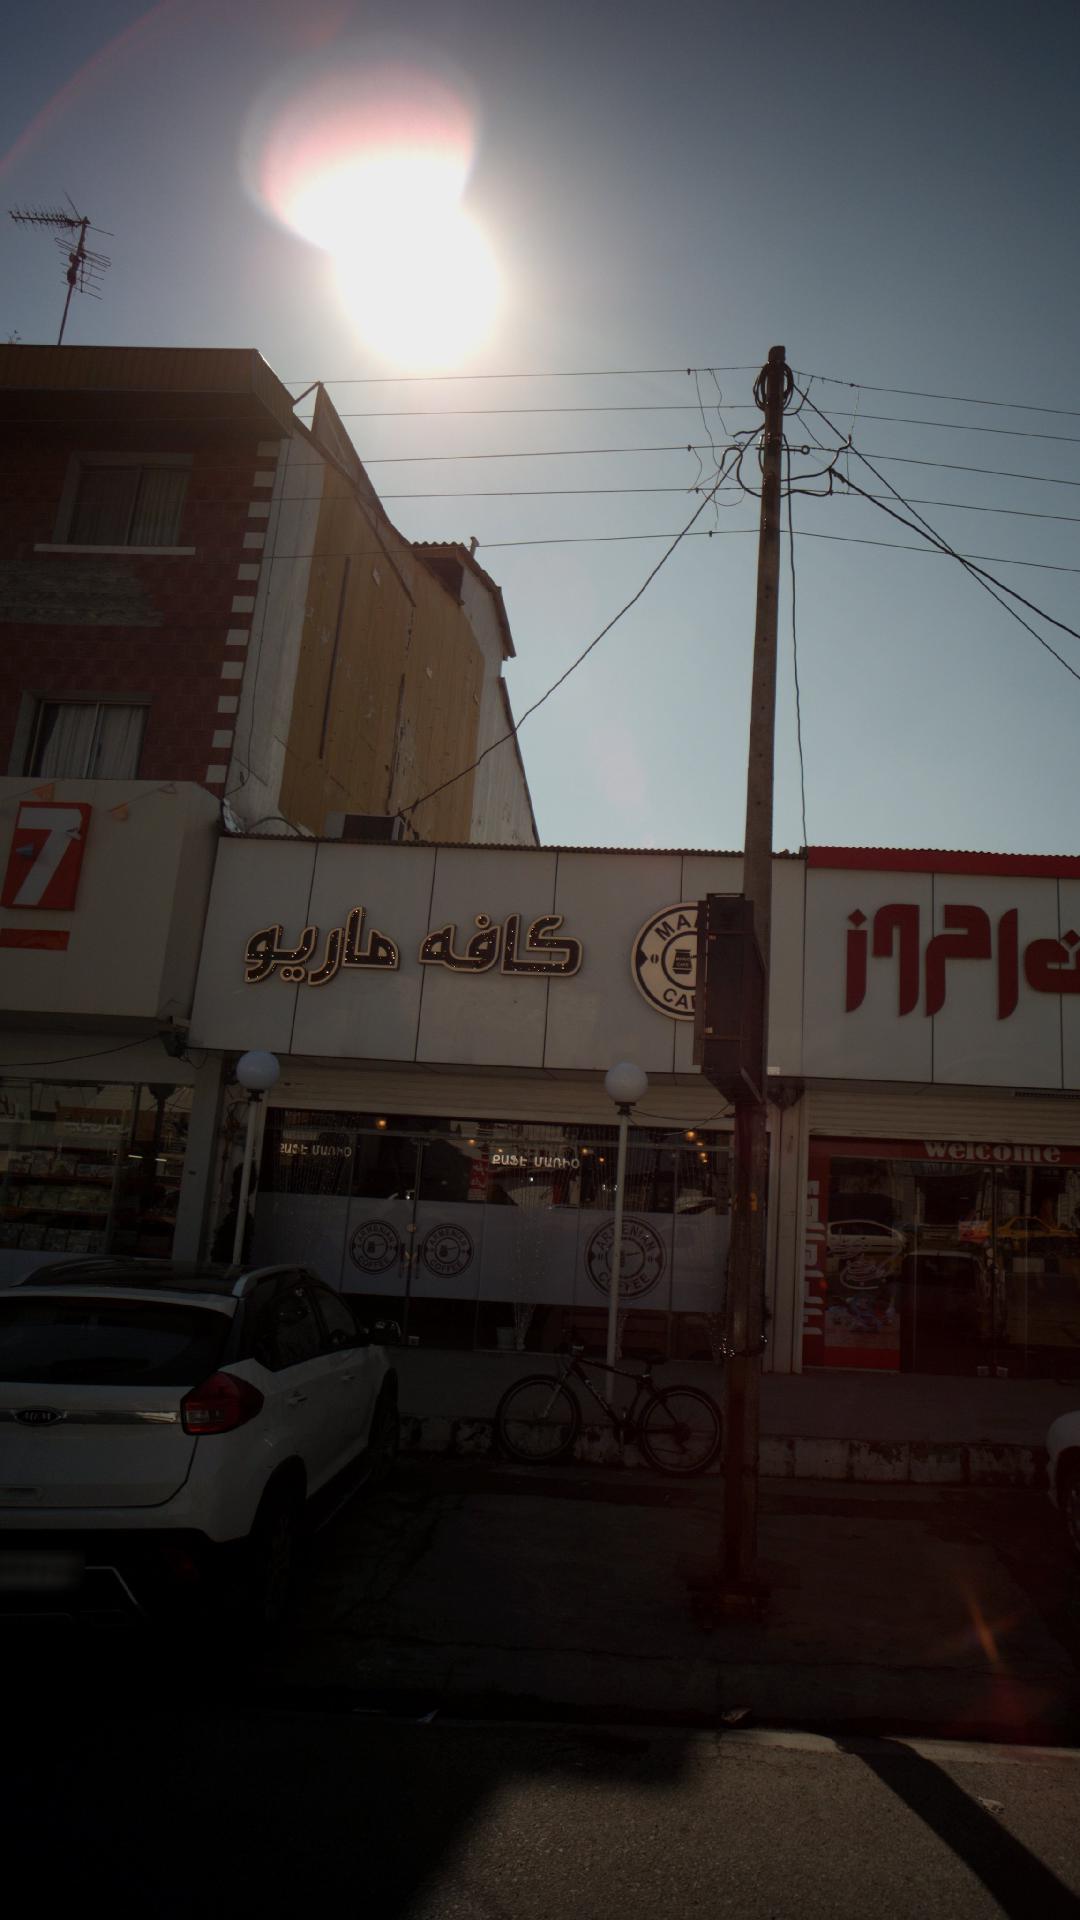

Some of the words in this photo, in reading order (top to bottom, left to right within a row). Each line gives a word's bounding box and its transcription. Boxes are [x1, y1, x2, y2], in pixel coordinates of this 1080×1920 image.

[244, 905, 400, 986] ماریو
[418, 912, 583, 976] کافه
[845, 903, 1018, 1020] امروز
[924, 1141, 1061, 1163] welcome
